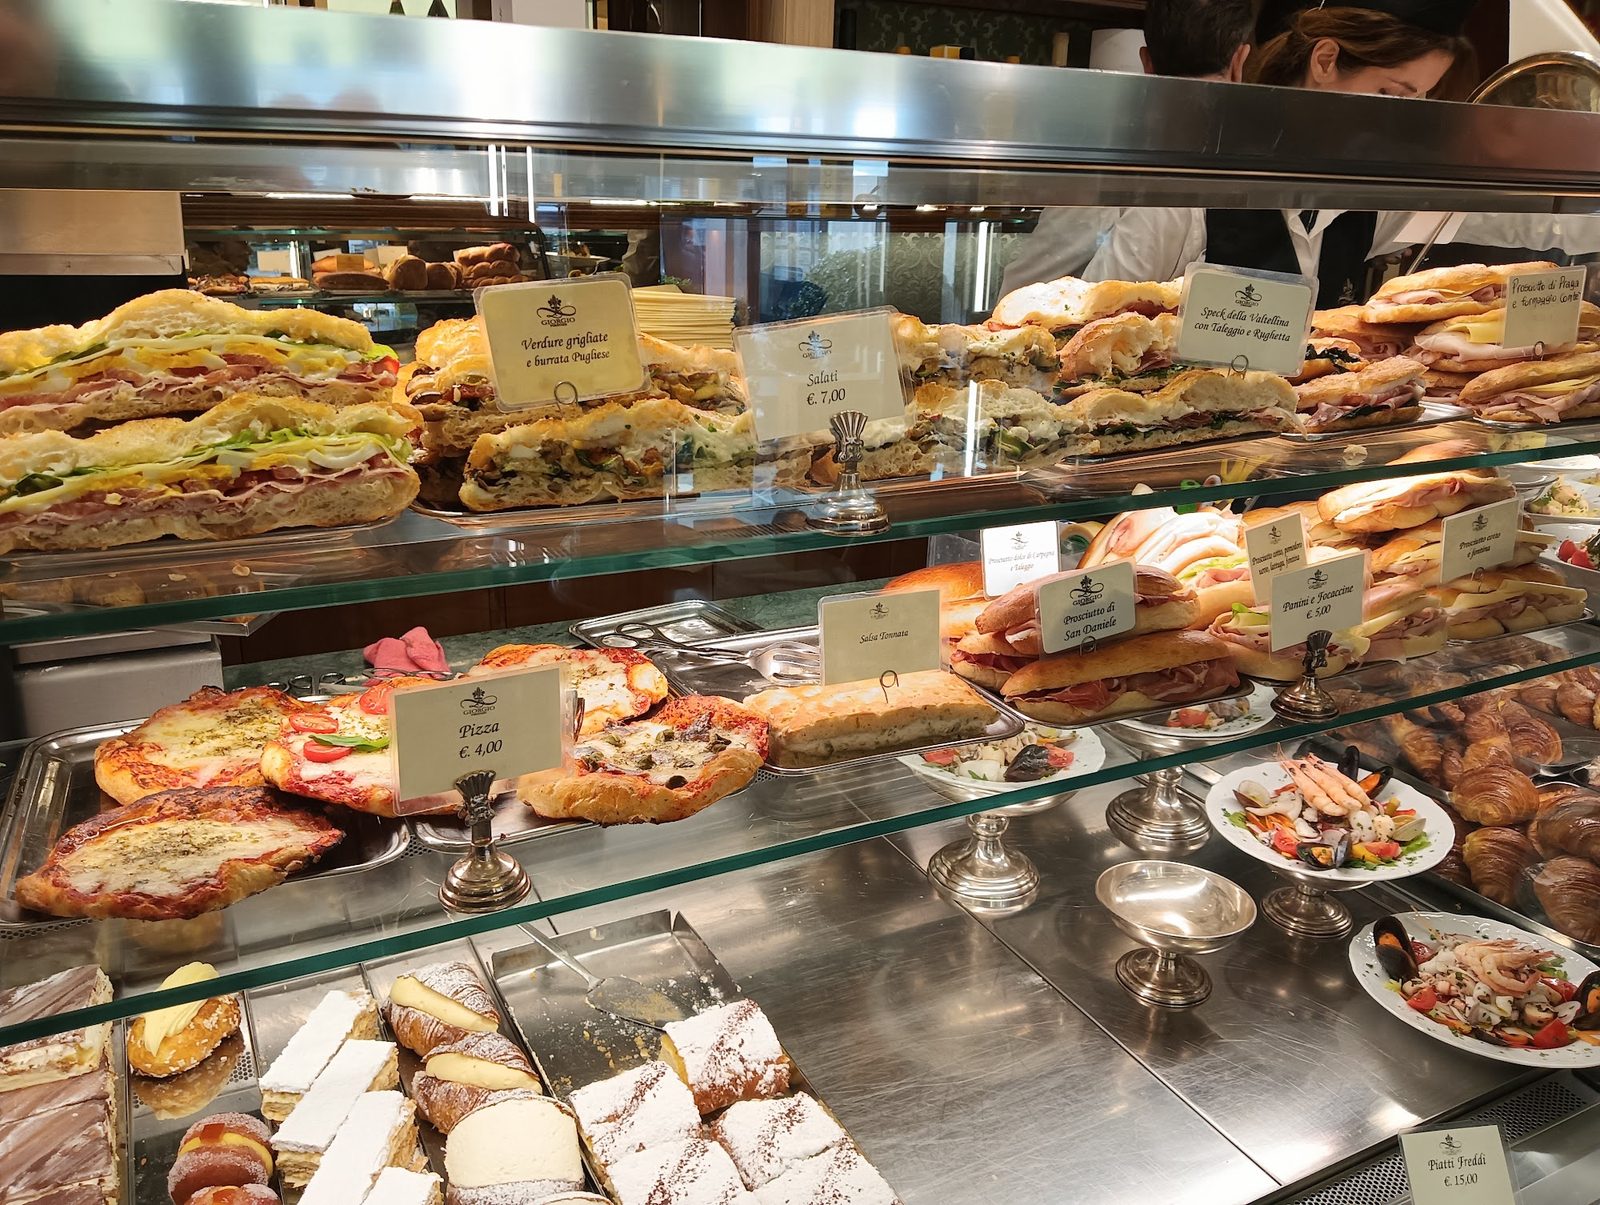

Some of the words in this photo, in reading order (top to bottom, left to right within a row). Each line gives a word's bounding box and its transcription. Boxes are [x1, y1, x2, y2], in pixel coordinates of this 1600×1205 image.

[1548, 279, 1557, 290] di
[1559, 276, 1579, 290] Praga
[541, 317, 576, 326] GIORGIO
[1201, 307, 1228, 320] Speck
[1227, 310, 1247, 321] della
[1249, 313, 1290, 327] Valtellina
[1194, 321, 1209, 331] con
[1211, 322, 1245, 337] Taleggio
[1253, 328, 1291, 342] Rughetta
[521, 336, 564, 350] Verdure
[566, 332, 608, 349] grigliate
[526, 359, 532, 367] e
[534, 354, 570, 367] burrata
[572, 349, 610, 364] Pugliese
[807, 370, 838, 387] Salati
[806, 393, 818, 405] €.
[821, 388, 846, 405] 7,00
[1072, 593, 1103, 606] GIORGIO
[1282, 595, 1309, 612] Panini
[1310, 596, 1315, 604] e
[1317, 585, 1354, 604] Focaccine
[1063, 608, 1105, 625] Prosciutto
[1106, 602, 1115, 613] di
[1315, 605, 1331, 617] 5,00
[859, 633, 878, 644] Salsa
[880, 630, 909, 640] Tonnata
[1064, 629, 1081, 641] San
[1082, 616, 1117, 635] Daniele
[463, 706, 496, 716] GIORGIO
[459, 722, 500, 739] Pizza
[459, 746, 471, 759] €.
[475, 740, 503, 757] 4,00
[1428, 1157, 1455, 1171] Piatti
[1457, 1153, 1487, 1170] Freddi
[1455, 1173, 1478, 1186] 15,00
